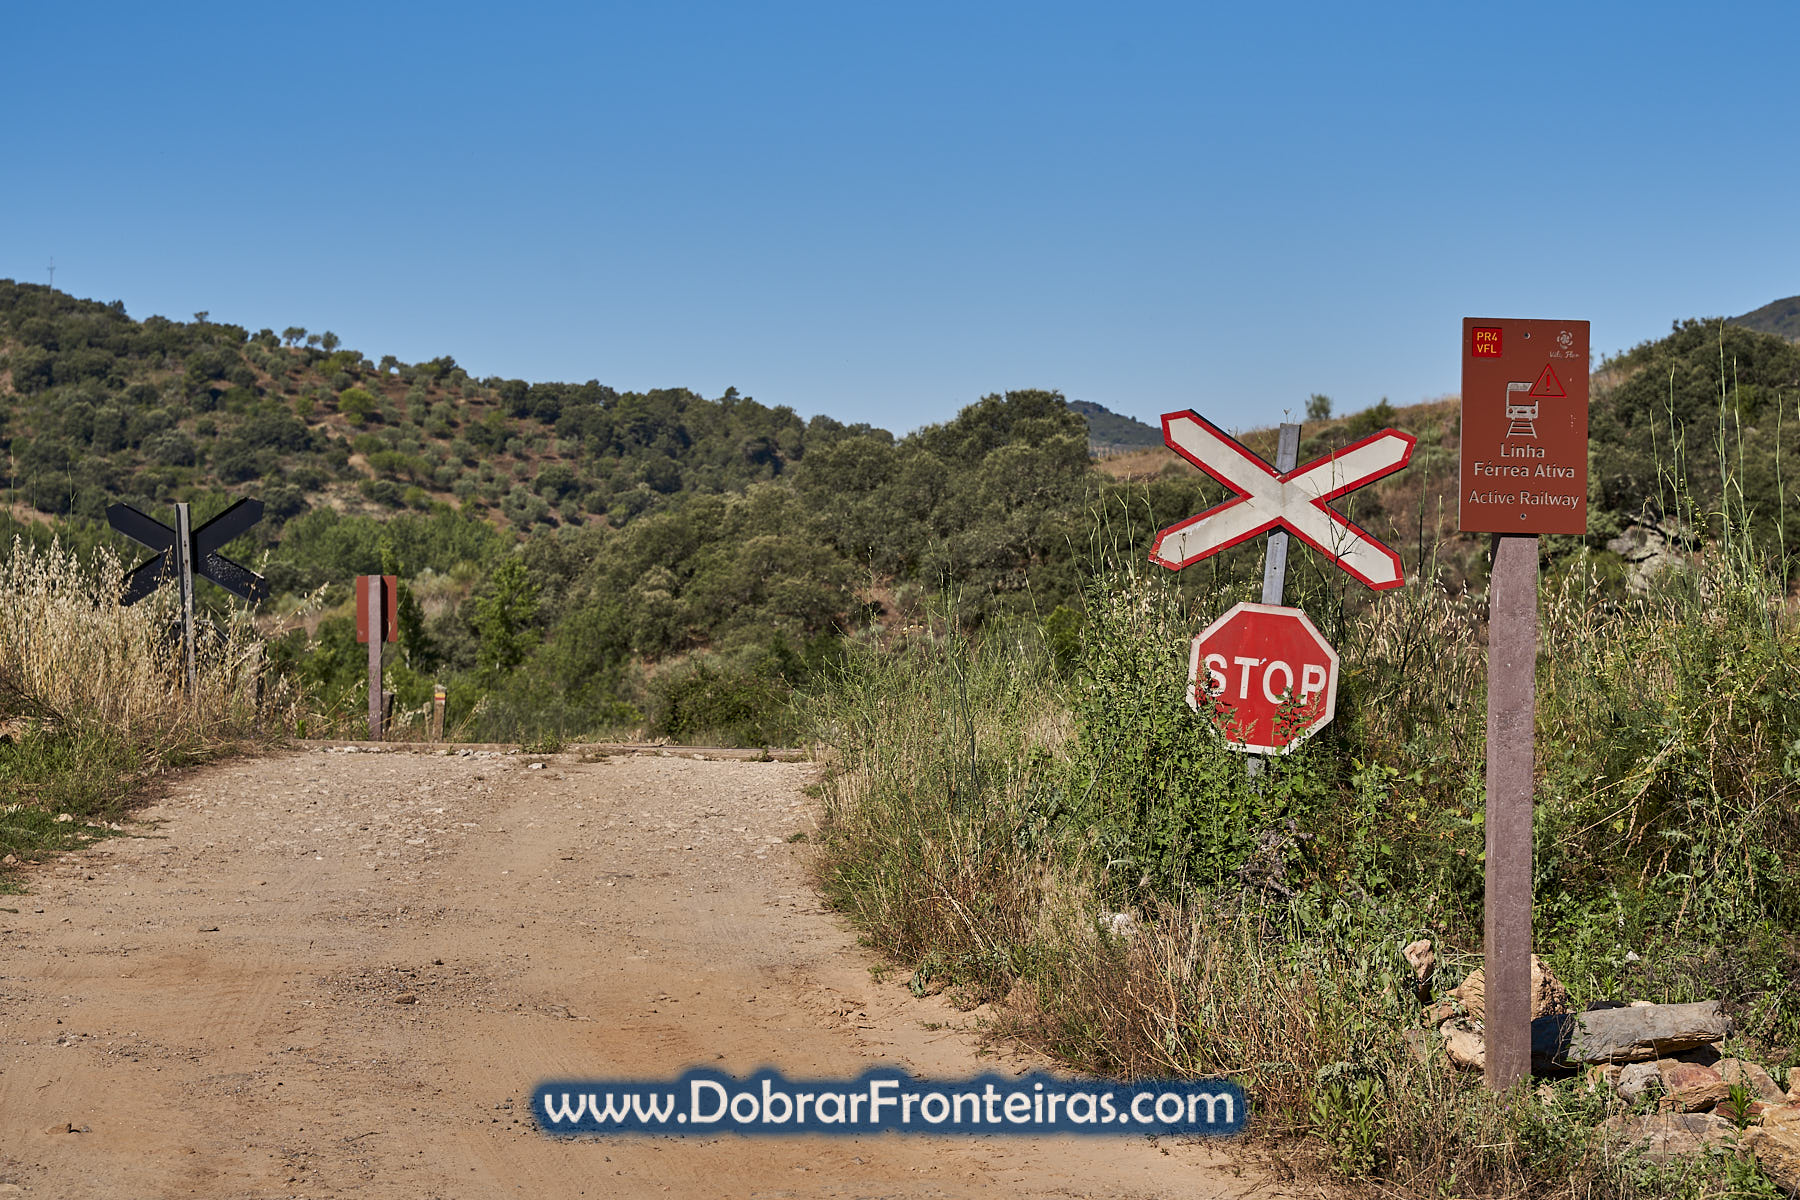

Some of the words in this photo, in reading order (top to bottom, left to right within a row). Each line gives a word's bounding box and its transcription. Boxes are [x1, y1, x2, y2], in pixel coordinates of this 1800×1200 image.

[1477, 331, 1498, 342] PR4
[1476, 343, 1497, 353] VFL
[1500, 443, 1545, 458] Linha
[1474, 460, 1529, 477] Férrea
[1534, 463, 1575, 478] Ativa
[1468, 490, 1515, 504] Active
[1520, 491, 1579, 509] Railway
[1203, 653, 1327, 705] STOP
